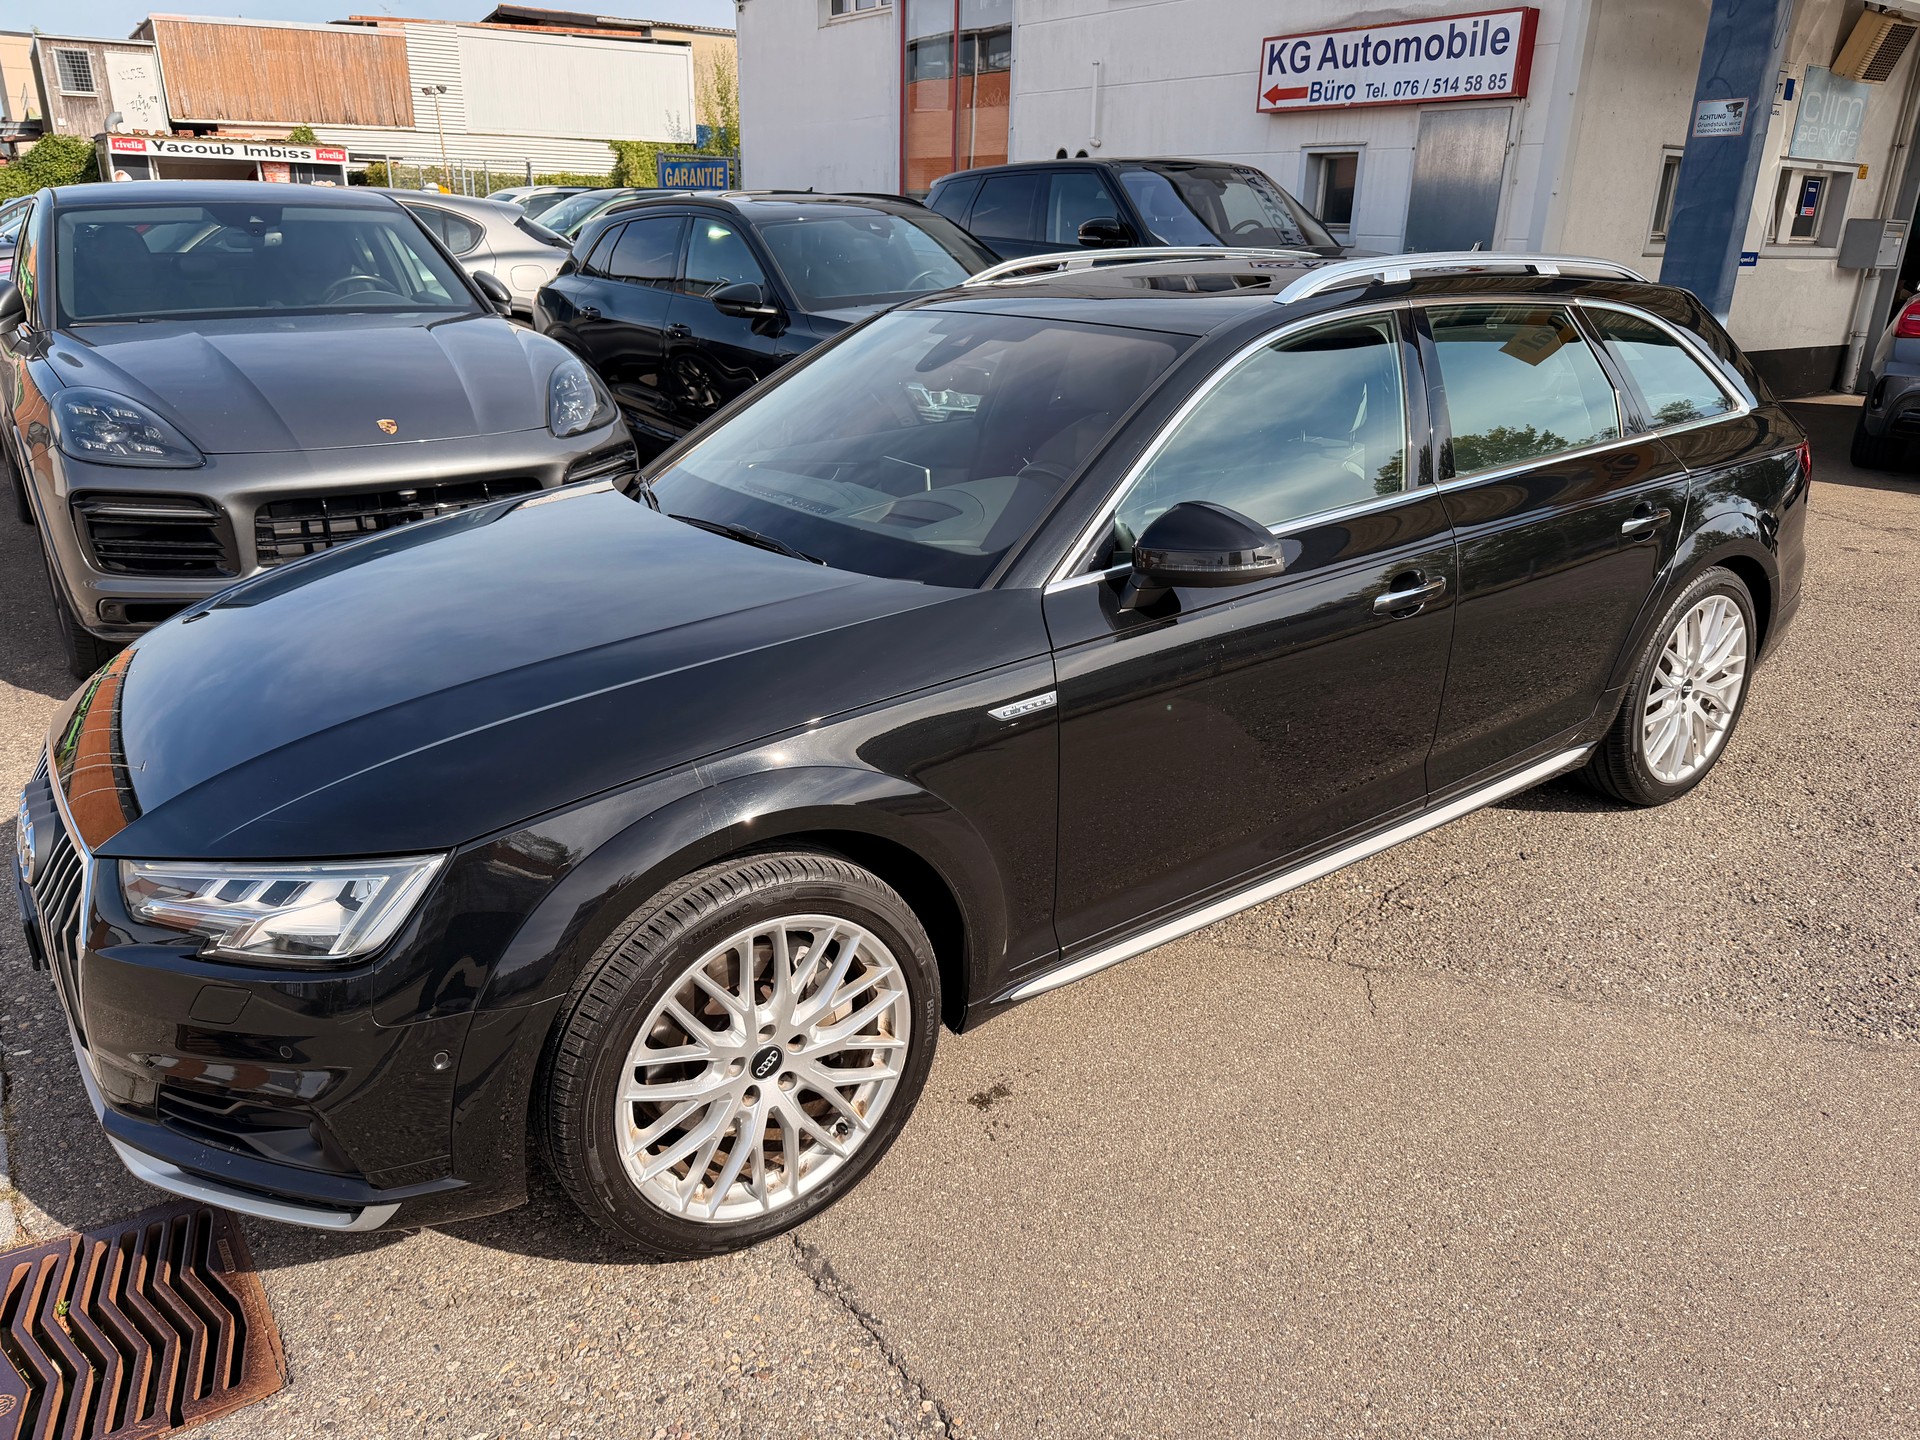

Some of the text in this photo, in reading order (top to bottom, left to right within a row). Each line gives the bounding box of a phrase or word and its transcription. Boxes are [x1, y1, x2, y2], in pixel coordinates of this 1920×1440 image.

[1267, 19, 1510, 75] KG Automobile
[1308, 73, 1507, 103] Büro Tel. 076 / 514 58 85
[1699, 113, 1727, 121] ACHTUNG
[115, 141, 143, 149] rivella
[152, 140, 311, 159] Yacoub Imbiss
[318, 152, 344, 160] rivella
[665, 167, 724, 187] GARANTIE
